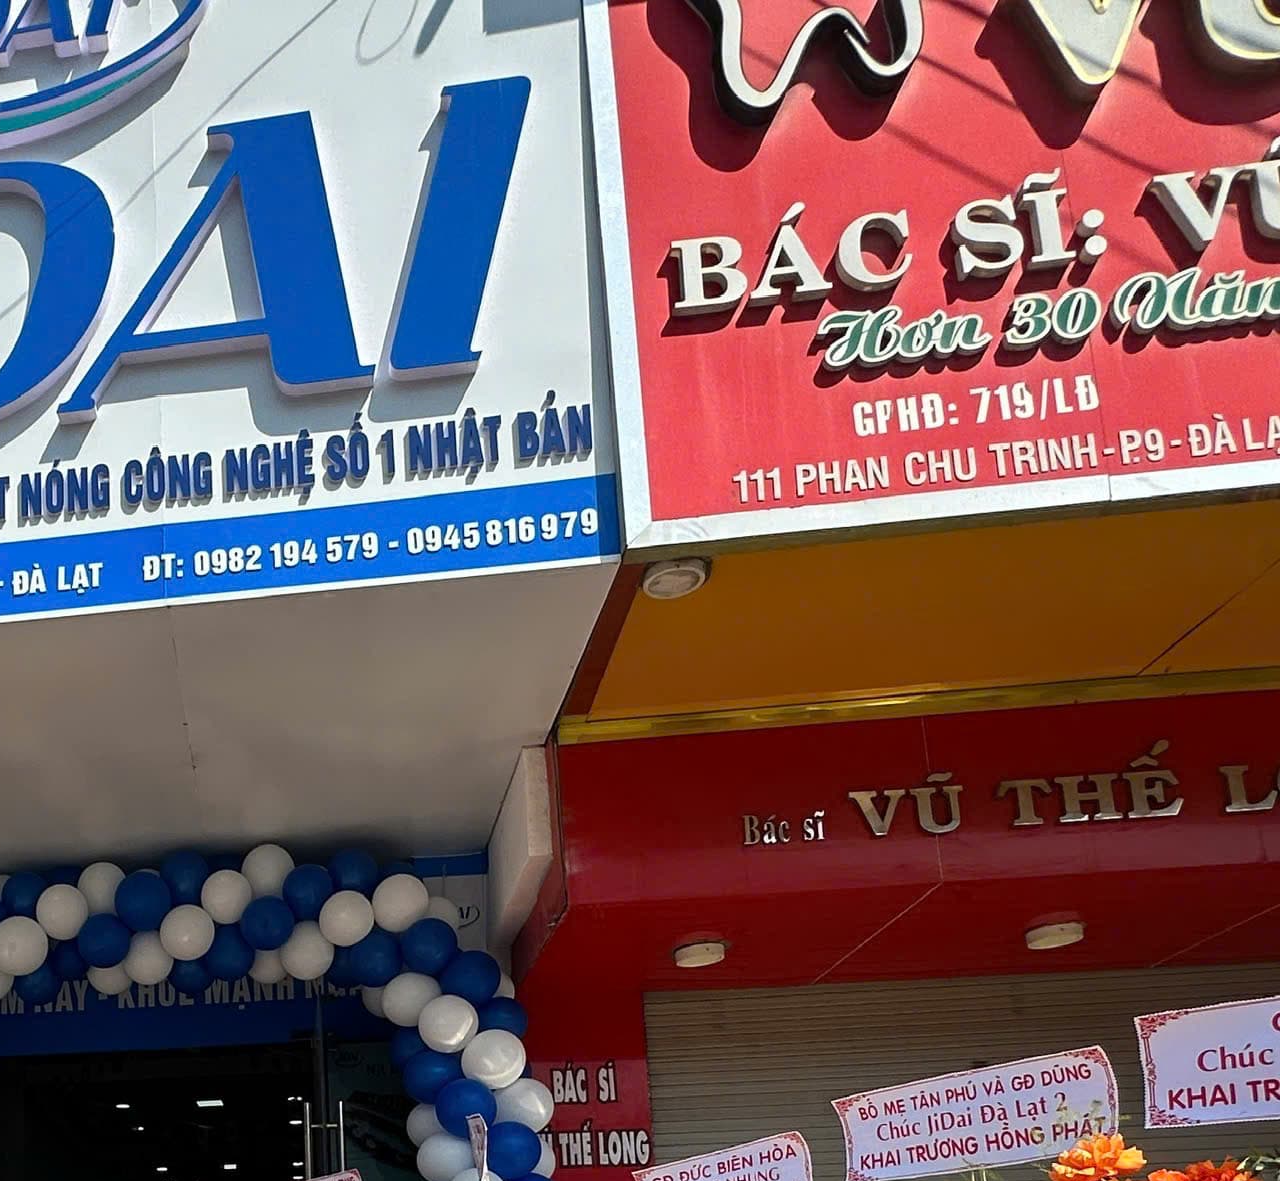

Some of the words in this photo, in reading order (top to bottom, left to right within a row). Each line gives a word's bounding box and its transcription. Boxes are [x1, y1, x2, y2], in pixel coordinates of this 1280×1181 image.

[669, 202, 913, 310] BÁC
[953, 168, 1108, 277] SĨ:
[820, 308, 992, 369] Hơn
[1005, 287, 1100, 345] 30
[852, 392, 960, 436] GPHĐ:
[969, 374, 1100, 424] 719/LĐ
[21, 459, 110, 518] NÓNG
[124, 446, 213, 505] CÔNG
[225, 429, 316, 497] NGHỆ
[326, 412, 370, 481] SỐ
[379, 428, 396, 474] 1
[407, 408, 502, 477] NHẬT
[517, 390, 593, 460] BẢN
[732, 466, 782, 503] 111
[795, 454, 890, 497] PHAN
[904, 447, 978, 486] CHU
[12, 563, 47, 596] ĐÀ
[57, 562, 104, 595] LẠT
[142, 553, 184, 582] ĐT:
[194, 545, 262, 576] 0982
[269, 538, 318, 569] 194
[326, 532, 379, 563] 579
[406, 521, 480, 556] 0945
[485, 513, 536, 545] 816
[540, 507, 599, 541] 979
[742, 813, 791, 845] Bác
[803, 809, 826, 842] sĩ
[848, 772, 964, 836] VŨ
[998, 739, 1185, 827] THẾ
[552, 1062, 588, 1104] BÁC
[1197, 1043, 1275, 1072] Chúc
[858, 1099, 879, 1121] BỐ
[883, 1100, 906, 1121] MẸ
[910, 1090, 941, 1112] TÂN
[945, 1081, 977, 1106] PHÚ
[982, 1076, 1006, 1097] VÀ
[1011, 1075, 1035, 1092] GĐ
[1041, 1063, 1092, 1088] DŨNG
[876, 1119, 921, 1142] Chúc
[927, 1109, 973, 1137] JiDai
[980, 1102, 1009, 1125] Đà
[1016, 1098, 1049, 1123] Lạt
[1053, 1092, 1068, 1112] 2
[1168, 1083, 1237, 1111] KHAI
[558, 1120, 593, 1166] THẾ
[598, 1130, 650, 1166] LONG
[717, 1154, 754, 1175] BIÊN
[759, 1144, 797, 1164] HÒA
[860, 1149, 901, 1172] KHAI
[905, 1134, 979, 1165] TRƯƠNG
[1051, 1114, 1106, 1142] PHÁT
